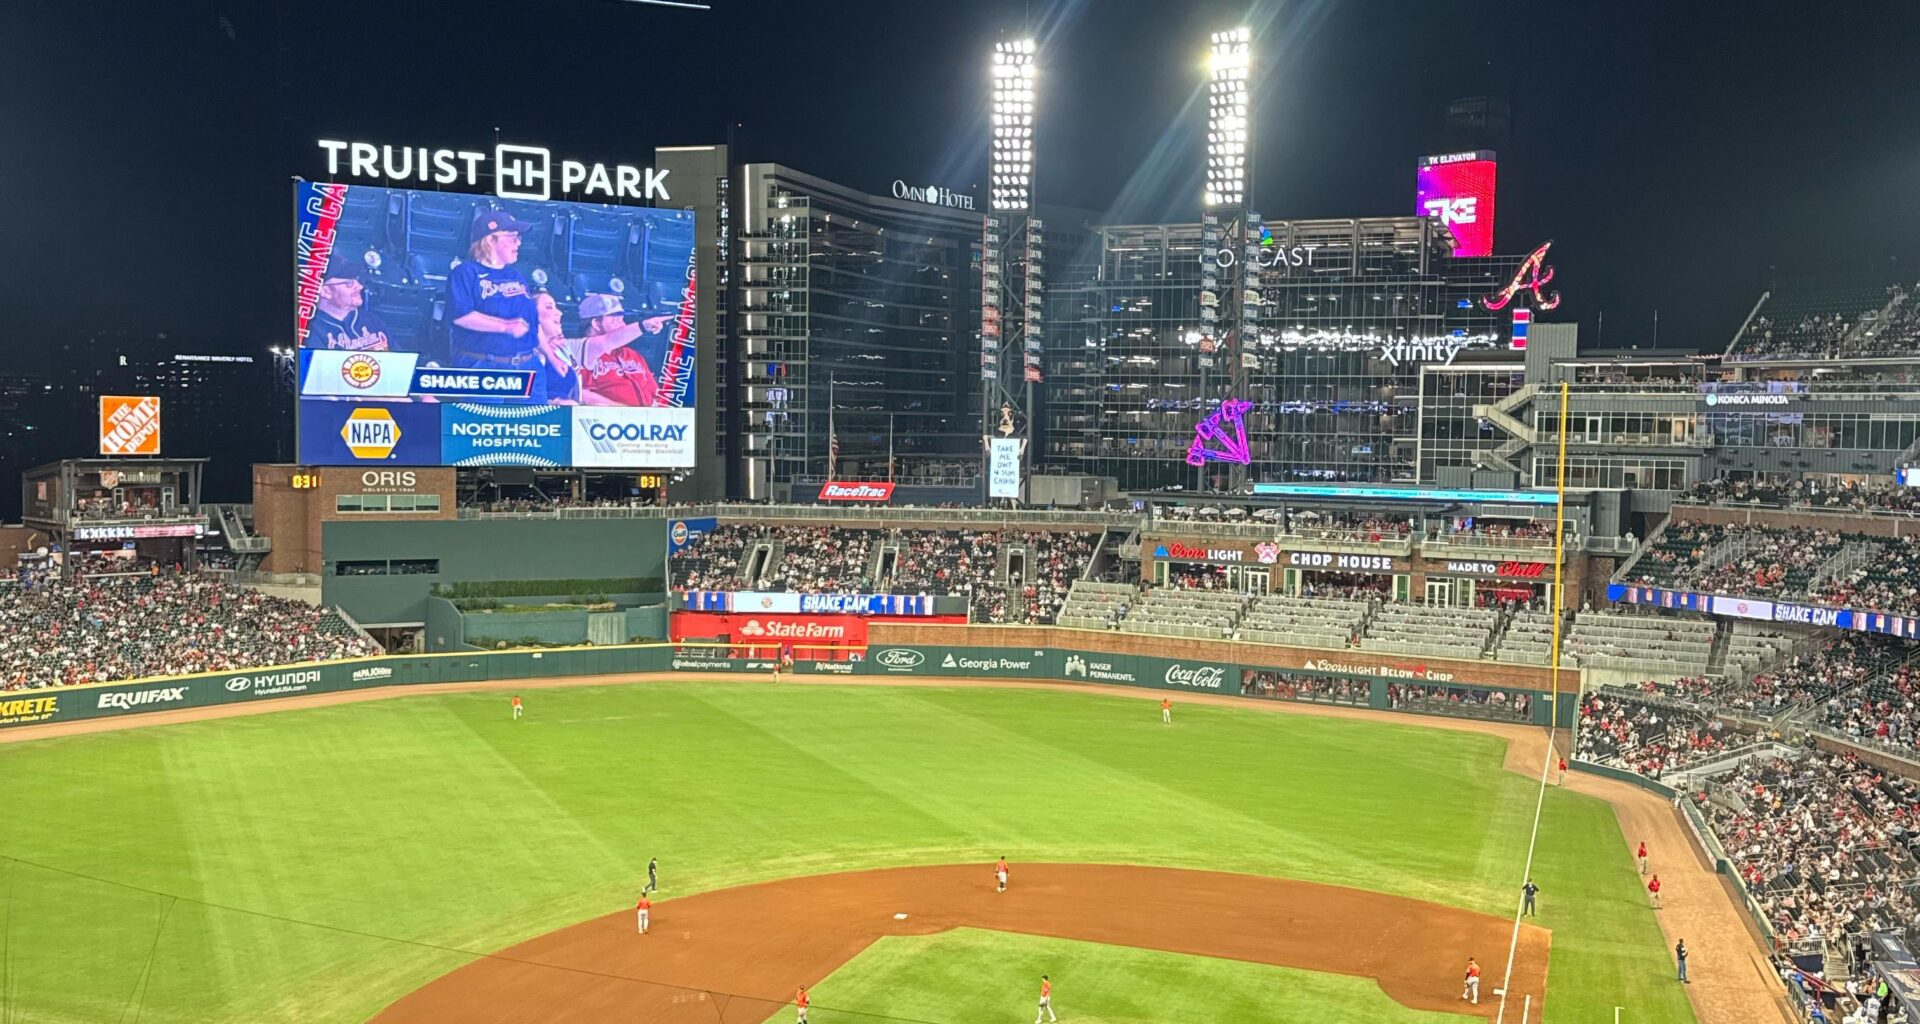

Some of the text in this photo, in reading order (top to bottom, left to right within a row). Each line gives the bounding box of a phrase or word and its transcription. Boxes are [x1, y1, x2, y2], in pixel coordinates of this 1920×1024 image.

[1429, 152, 1477, 165] TK ELEVATOR
[318, 139, 670, 200] TRUIST PARK
[892, 179, 976, 211] OMNI HOTEL
[1380, 337, 1461, 366] xfinity
[119, 356, 127, 366] R
[420, 375, 522, 390] SHAKE CAM
[1718, 395, 1789, 404] KONICA MINOLTA
[107, 402, 133, 426] THE
[102, 397, 159, 453] HOME
[352, 423, 391, 443] NAPA
[452, 422, 561, 437] NORTHSIDE
[589, 423, 688, 441] COOLRAY
[124, 418, 159, 453] DEPOT
[472, 438, 542, 448] HOSPITAL
[119, 473, 160, 483] CLUBHOUSE
[362, 471, 416, 486] ORIS
[825, 485, 886, 497] RaceTrac
[1169, 542, 1244, 561] Coors LIGHT
[1290, 552, 1392, 569] CHOP HOUSE
[1448, 561, 1546, 578] MADE TO Chill
[803, 596, 870, 611] SHAKE CAM
[1775, 604, 1837, 626] SHAKE CAM
[766, 621, 844, 638] State Farm
[884, 650, 916, 664] Ford
[959, 658, 1031, 670] Georgia Power
[1090, 662, 1112, 671] KAISER
[1316, 659, 1348, 673] Coors
[1349, 665, 1377, 676] LIGHT
[1380, 666, 1414, 678] BELOW
[1426, 670, 1454, 682] CHOP
[254, 670, 320, 688] HYUNDAI
[1090, 671, 1135, 682] PERMANENTE
[1165, 664, 1226, 688] Coca-Cola
[97, 687, 185, 710] EQUIFAX
[254, 684, 306, 696] HyundaiUSA.com
